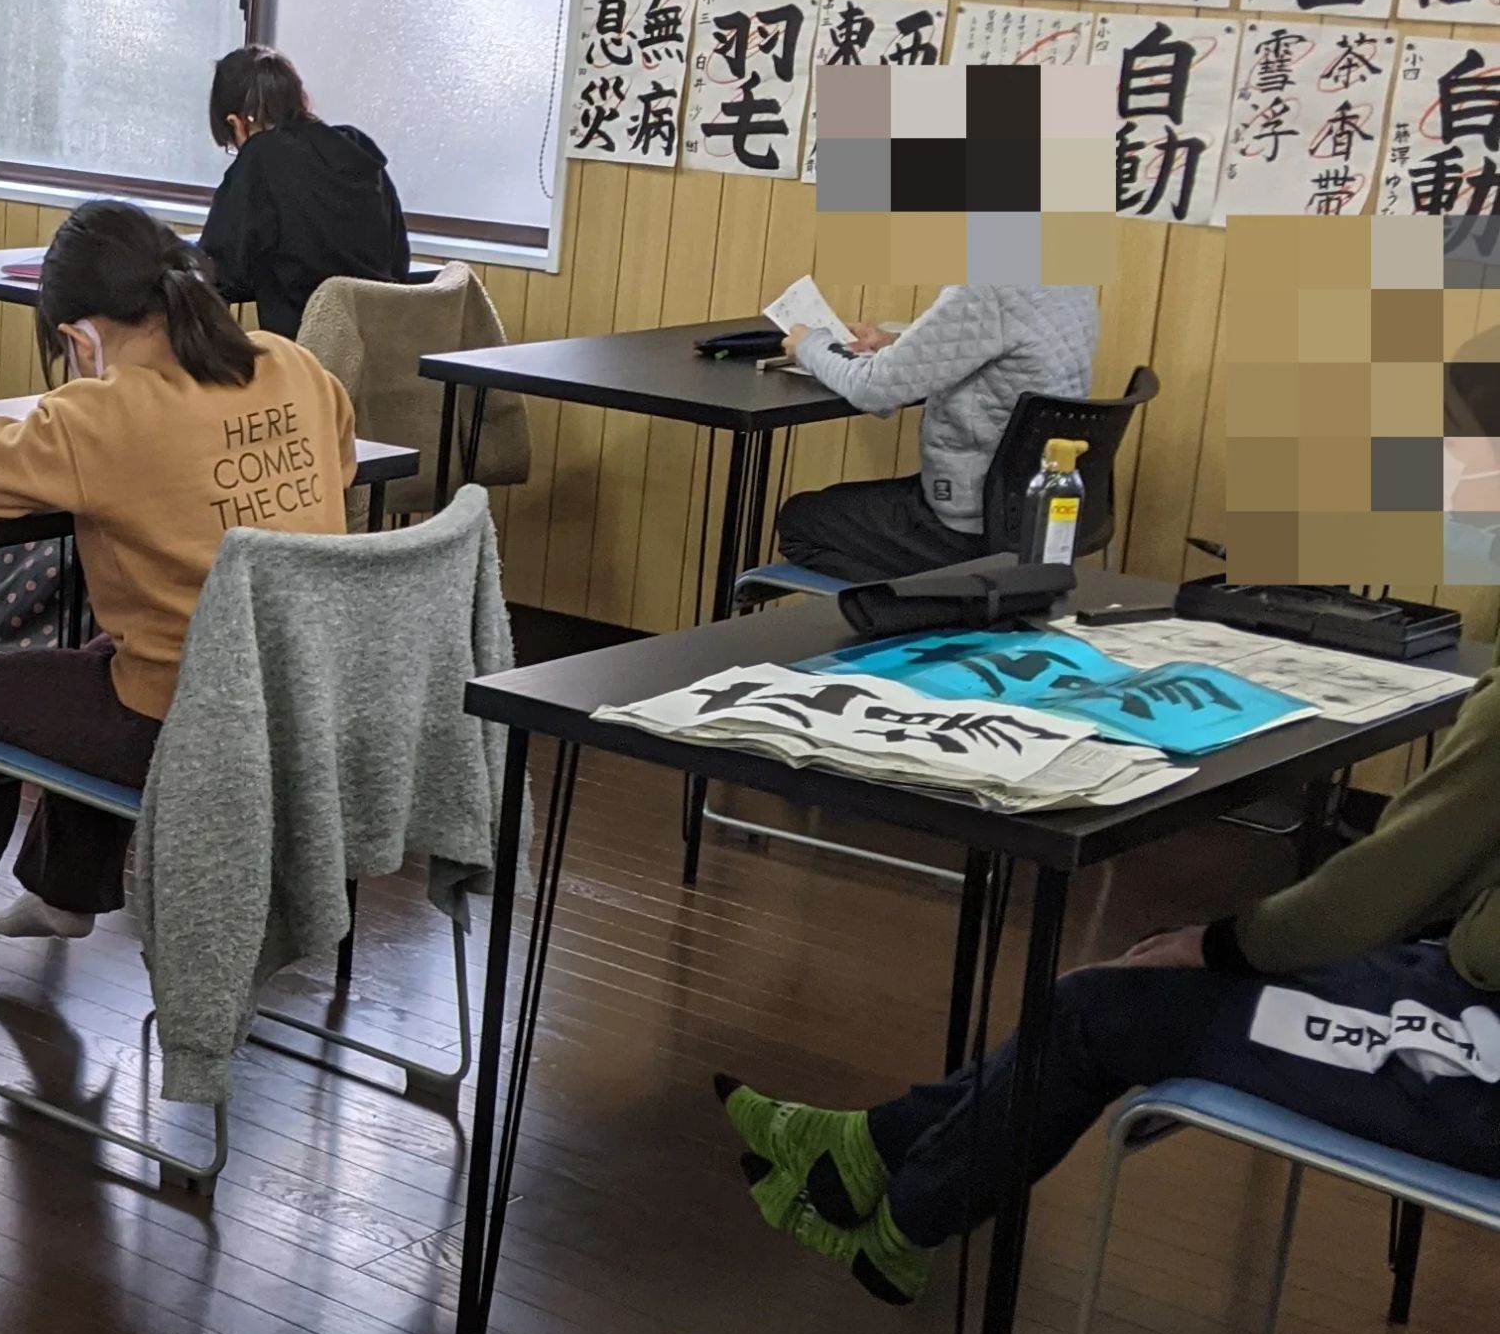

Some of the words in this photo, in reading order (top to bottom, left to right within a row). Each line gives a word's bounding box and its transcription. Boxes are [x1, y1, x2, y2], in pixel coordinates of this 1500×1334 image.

[701, 4, 804, 169] 羽毛
[224, 403, 298, 449] HERE
[213, 437, 315, 489] COMES
